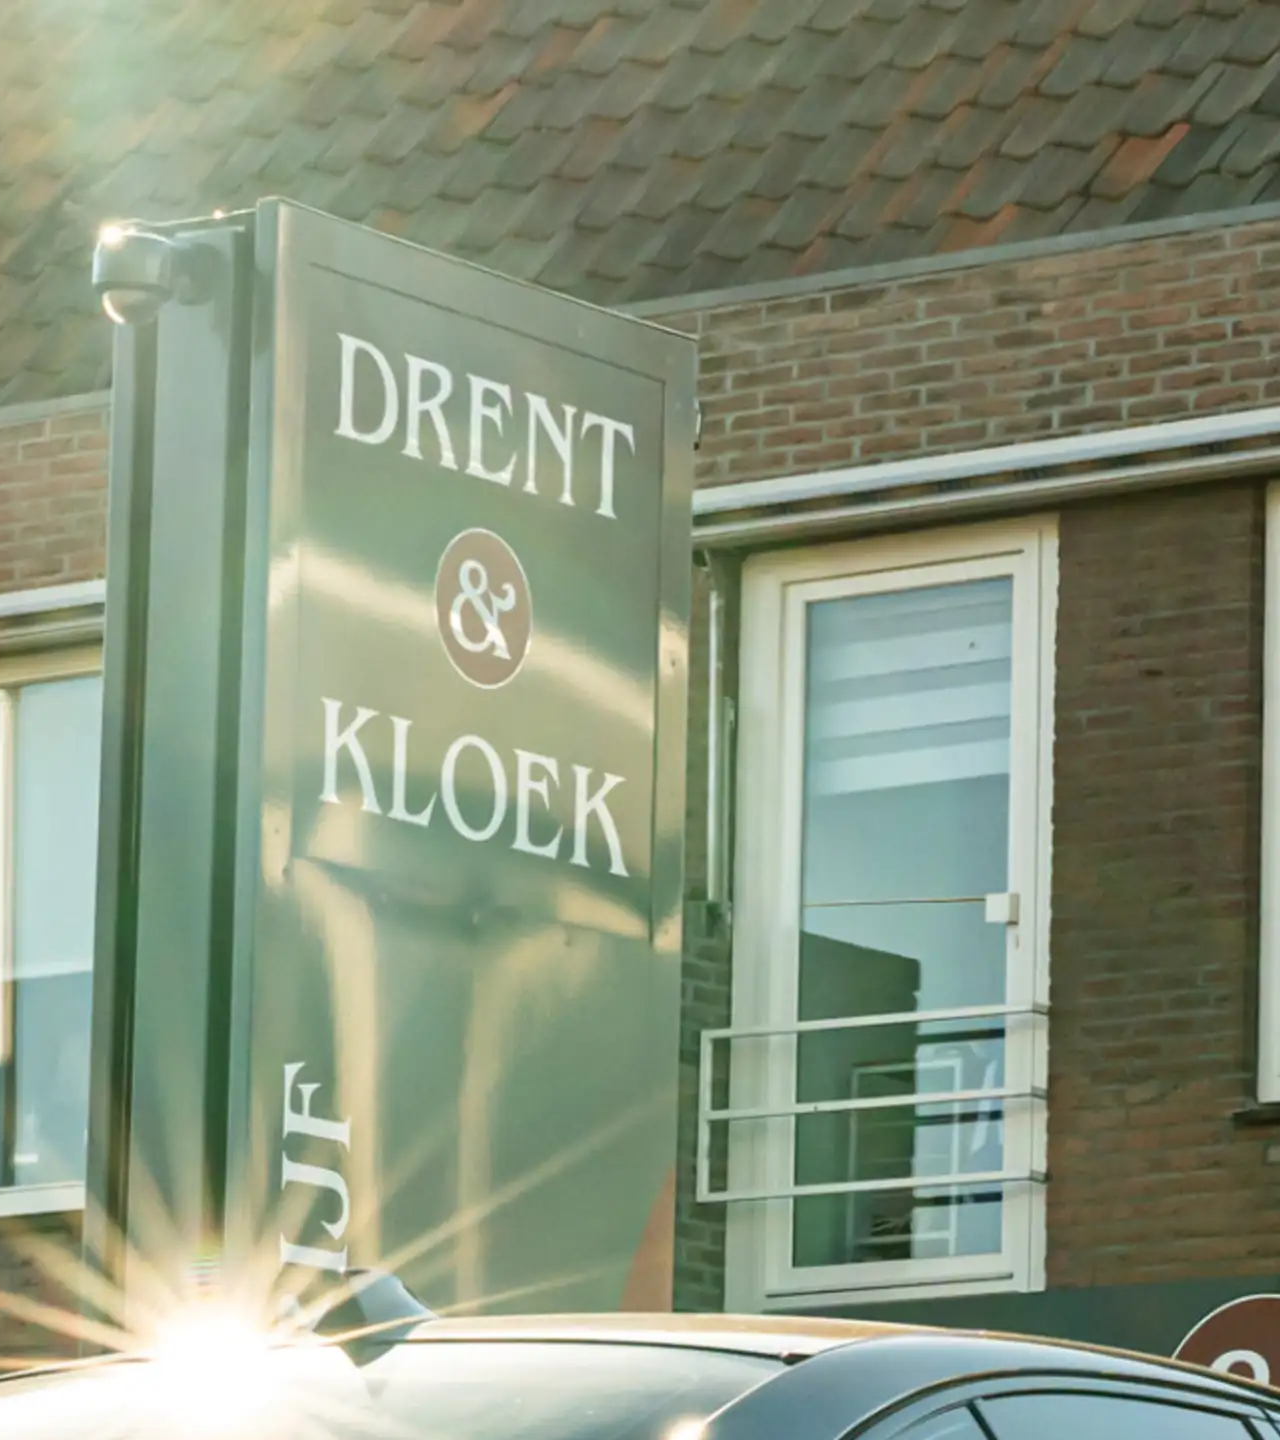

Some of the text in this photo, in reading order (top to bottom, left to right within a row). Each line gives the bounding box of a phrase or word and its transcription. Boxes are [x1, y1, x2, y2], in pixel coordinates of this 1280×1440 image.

[333, 331, 636, 520] DRENT
[449, 558, 517, 660] &
[319, 695, 630, 878] KLOEK
[279, 1061, 352, 1322] IJF
